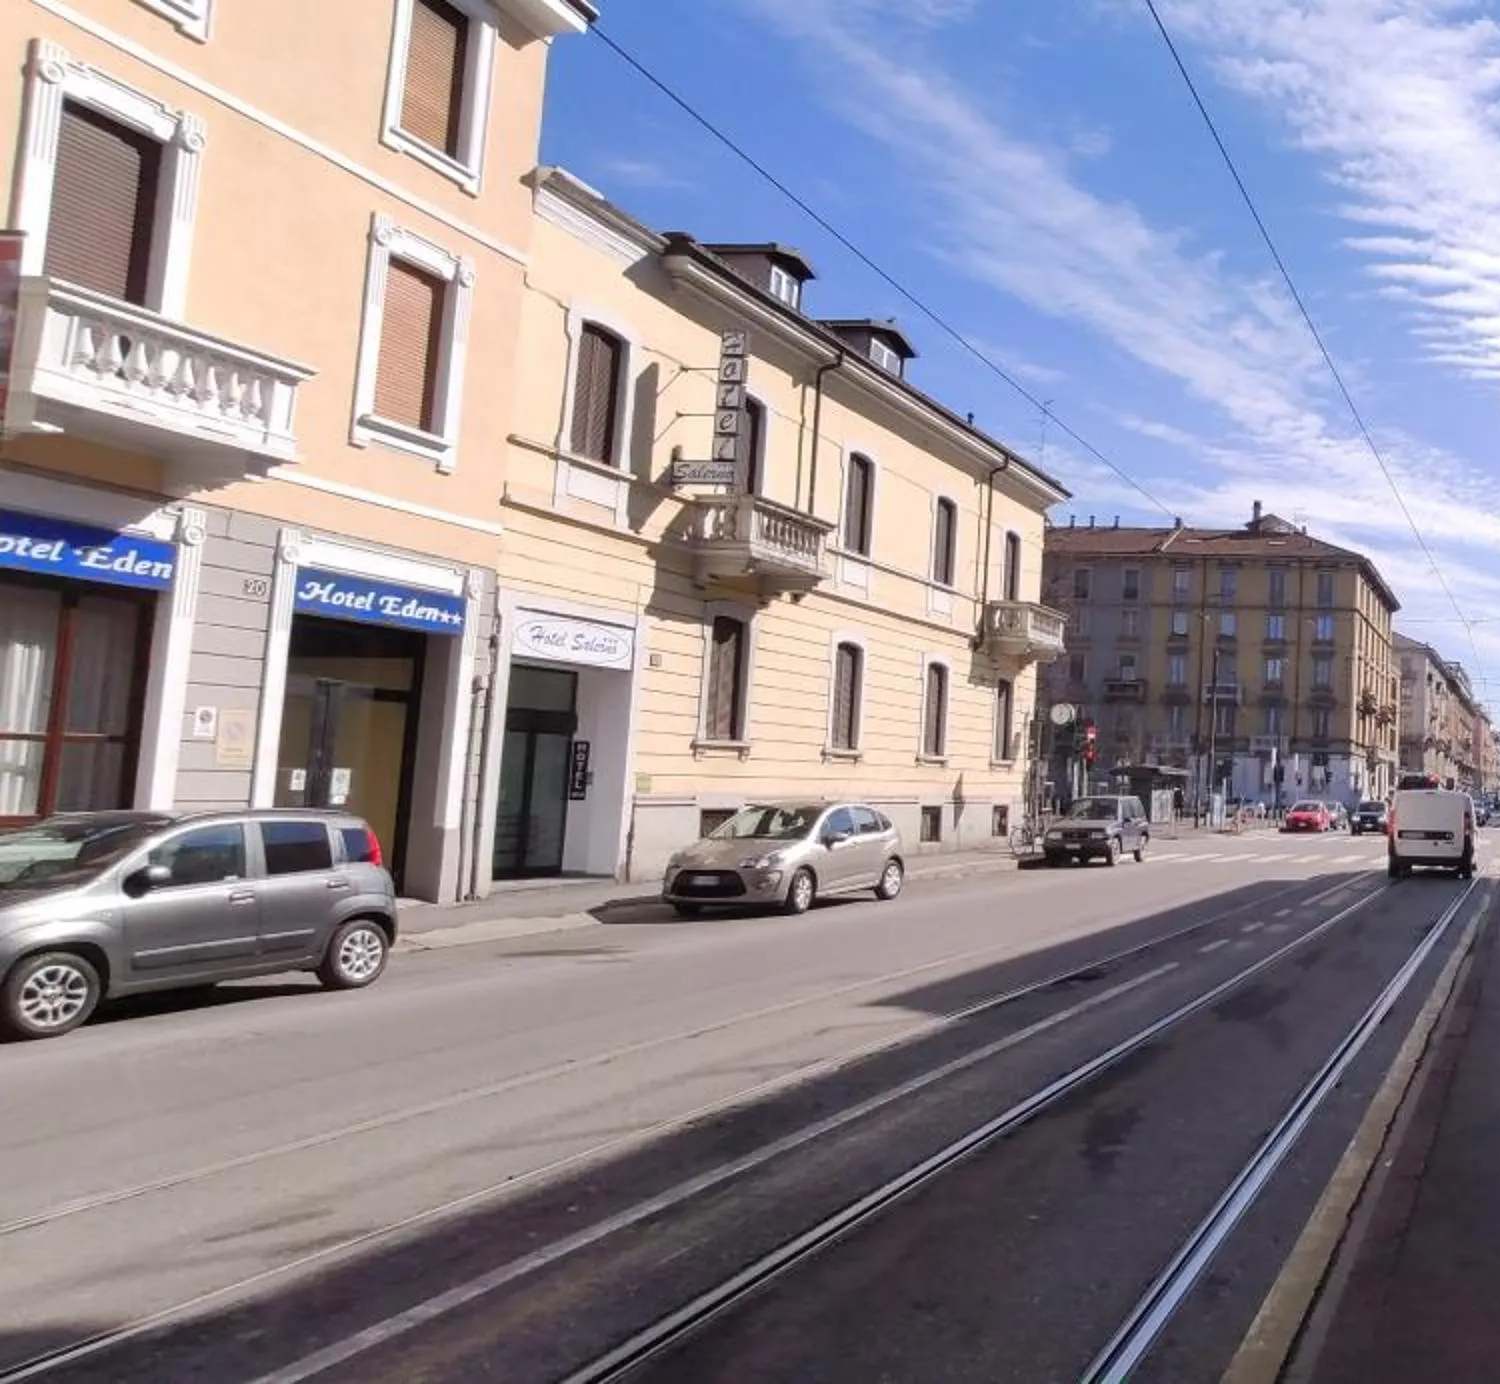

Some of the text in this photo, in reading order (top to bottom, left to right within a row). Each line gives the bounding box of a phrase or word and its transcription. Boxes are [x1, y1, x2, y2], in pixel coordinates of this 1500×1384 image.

[73, 545, 173, 579] Eden
[299, 581, 439, 622] Hotel Eden
[529, 625, 567, 647] Hotel
[575, 743, 587, 789] HOTEL
